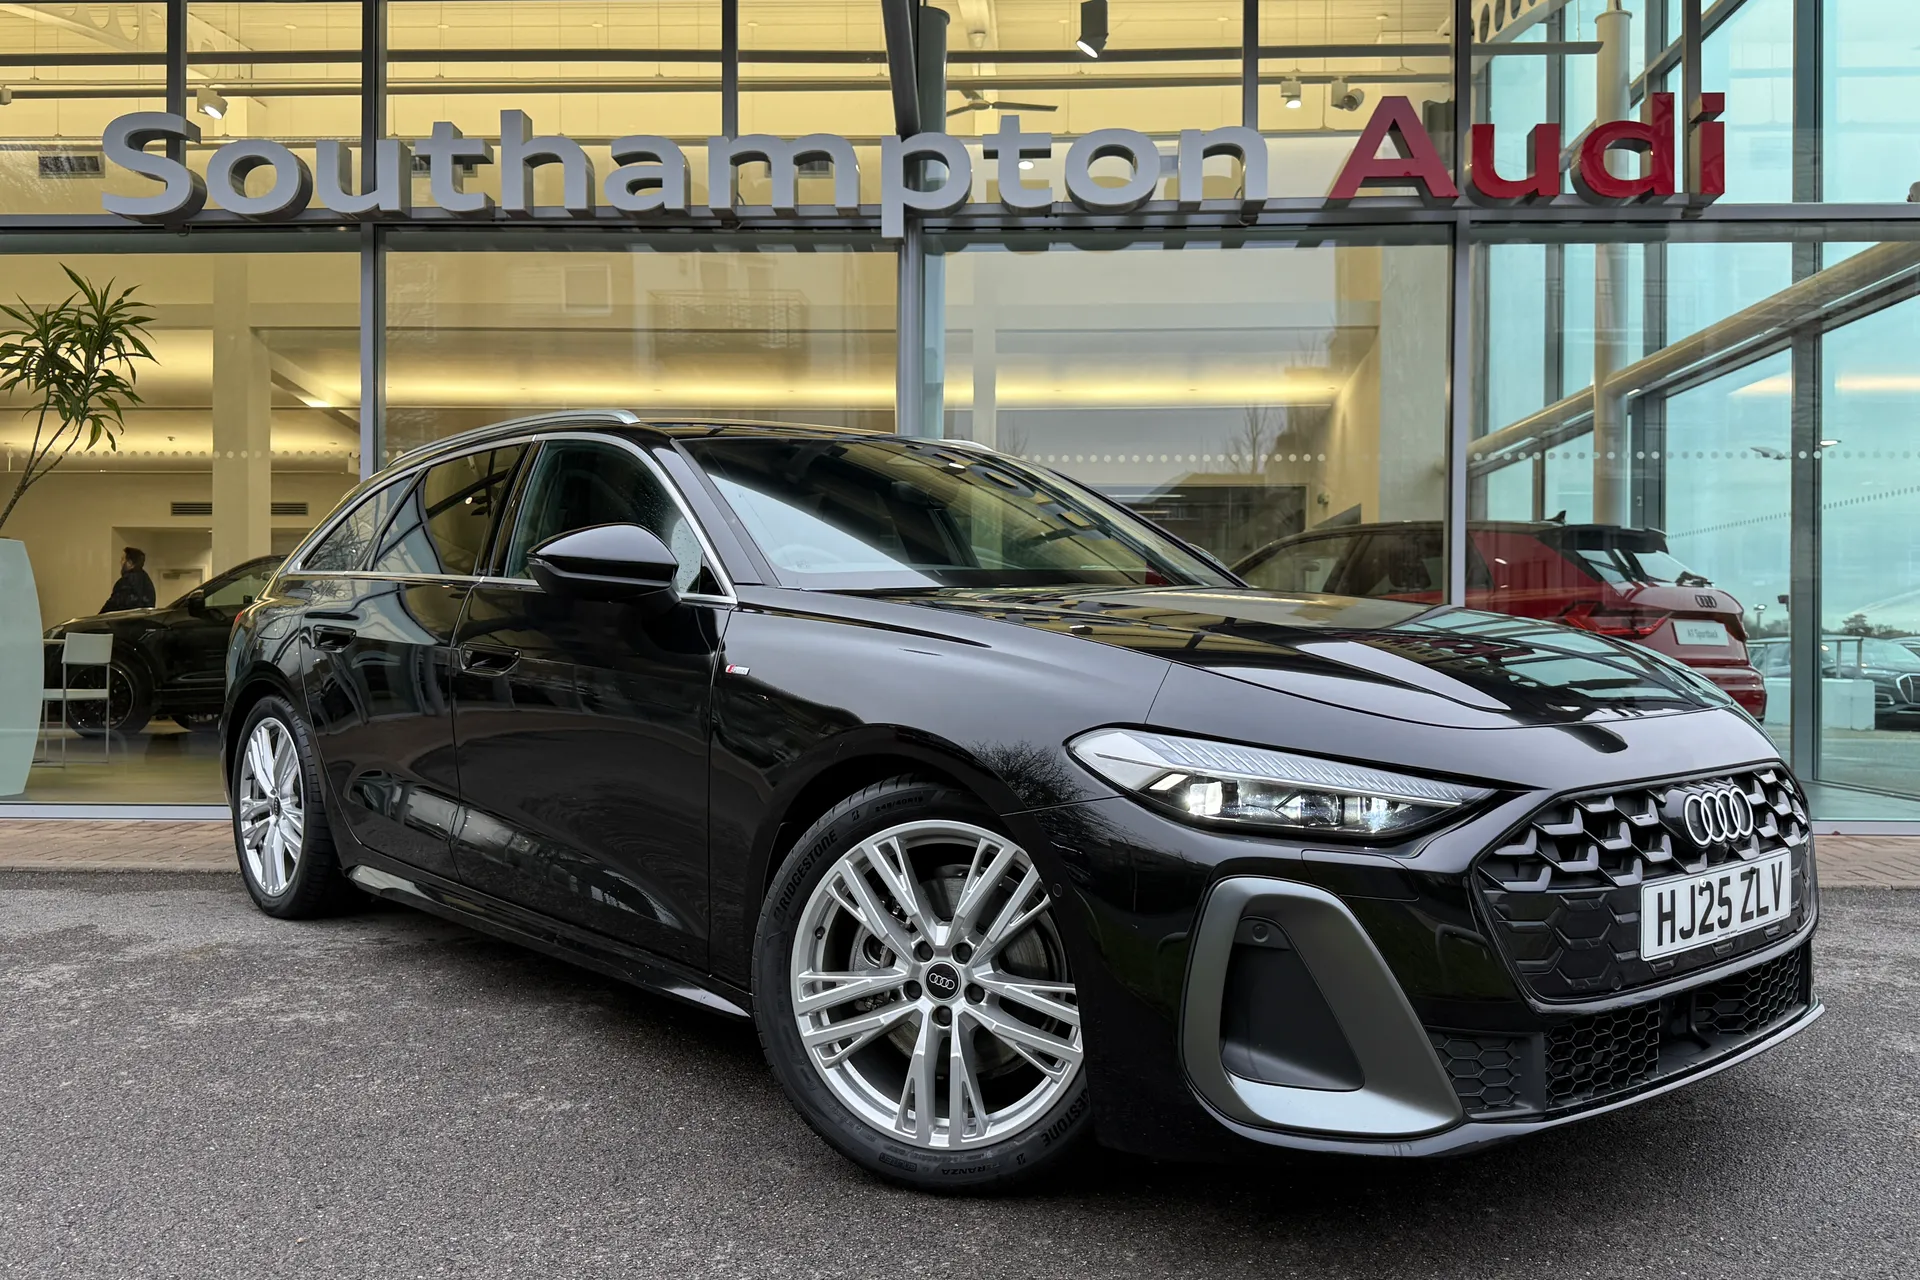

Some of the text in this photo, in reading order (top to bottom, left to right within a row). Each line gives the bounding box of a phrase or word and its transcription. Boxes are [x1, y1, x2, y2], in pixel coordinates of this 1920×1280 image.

[101, 92, 1725, 238] Southampton Audi
[773, 829, 839, 923] BRIDGESTONE
[1657, 861, 1783, 947] HJ25 ZLV
